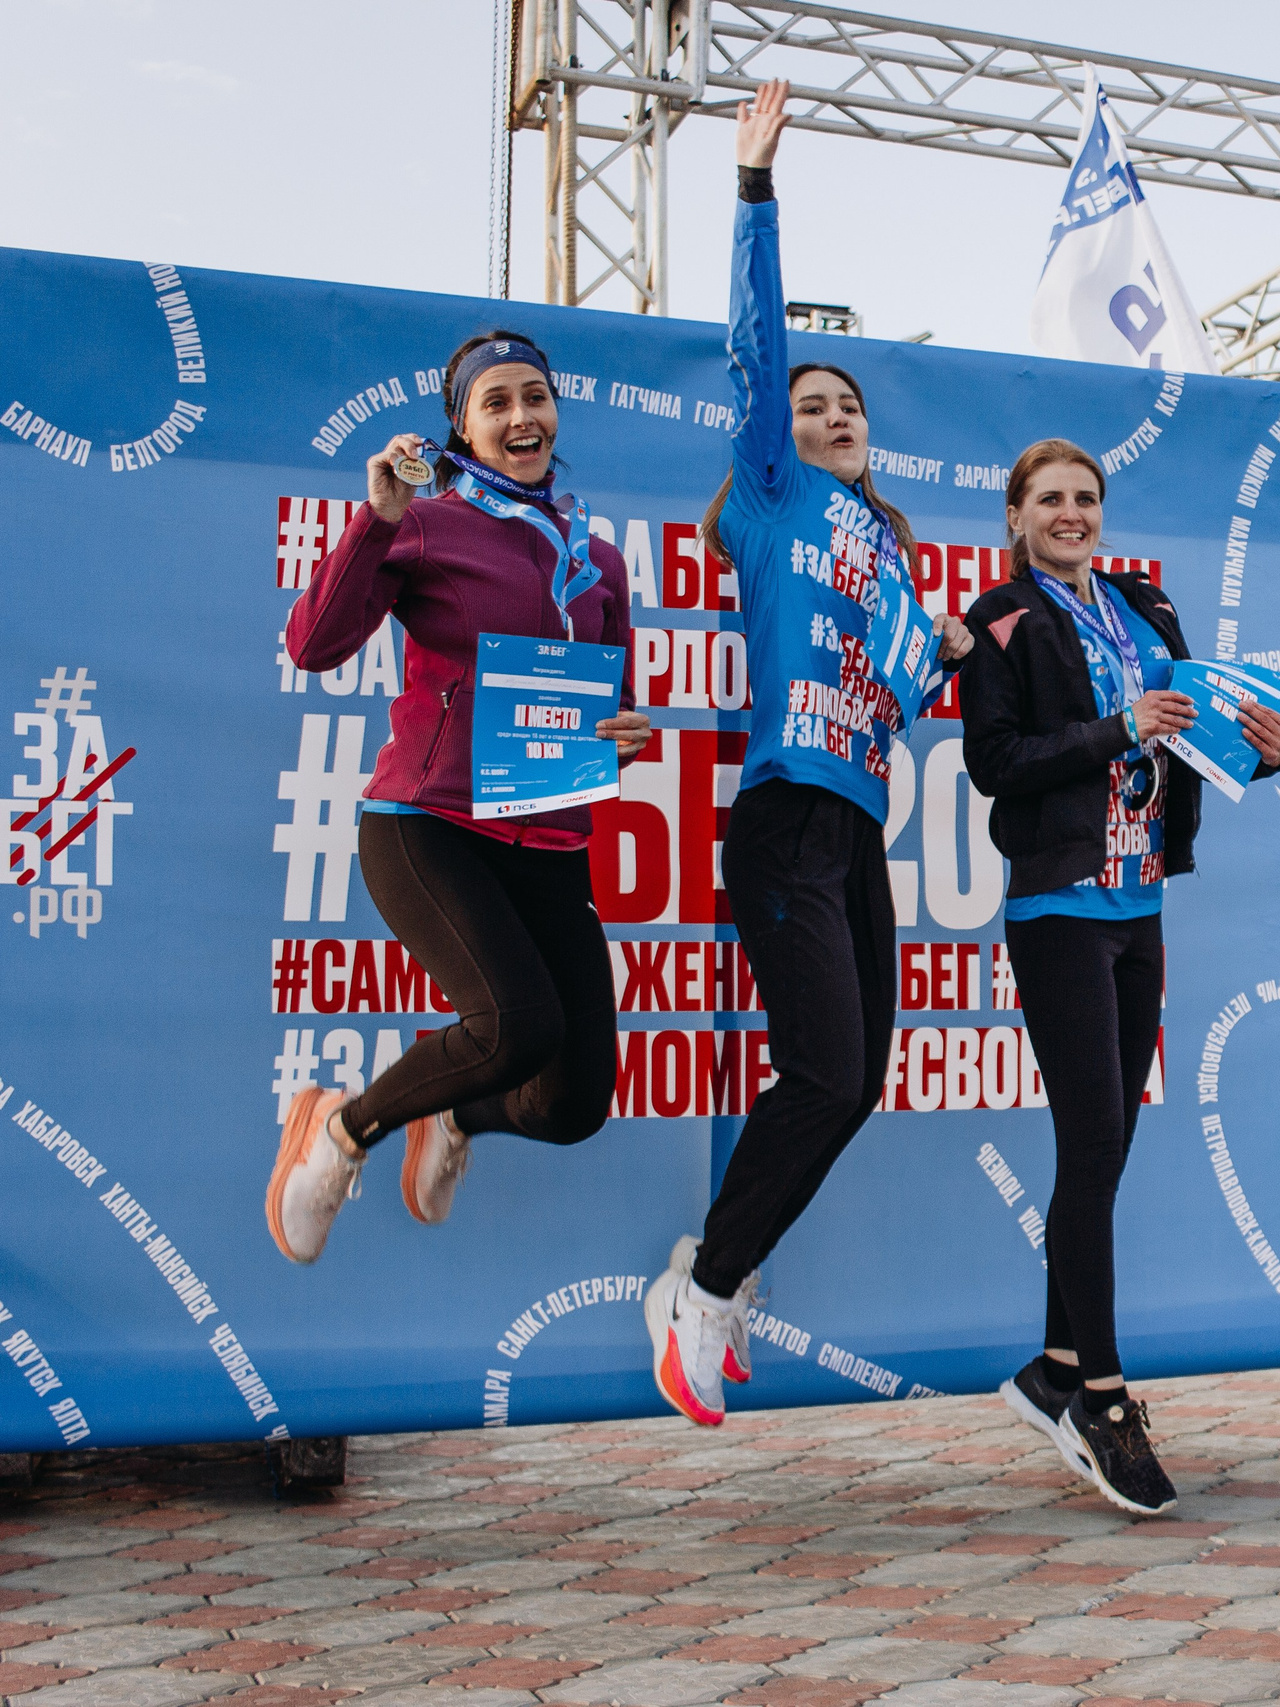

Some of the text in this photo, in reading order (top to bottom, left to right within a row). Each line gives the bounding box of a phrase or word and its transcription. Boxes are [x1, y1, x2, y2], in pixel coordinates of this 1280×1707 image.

[156, 290, 206, 383] ВЕЛИКИЙ
[0, 400, 92, 467] БАРНАУЛ
[311, 377, 409, 457] ВОЛГОГРАД
[609, 382, 682, 420] ГАТЧИНА
[110, 400, 207, 472] БЕЛГОРОД
[954, 463, 1011, 491] ЗАРАЙС
[1100, 417, 1163, 476] ИРКУТСК
[483, 495, 508, 513] ПСБ
[1236, 443, 1276, 509] МАЙКОП
[824, 491, 881, 546] 2024
[1220, 515, 1251, 606] МАХАЧКАЛА
[1216, 618, 1238, 660] МОСК
[526, 742, 564, 759] 10 КМ
[527, 705, 582, 730] МЕСТО
[783, 714, 853, 763] #ЗАБЕГ
[1177, 743, 1194, 758] ПСБ
[513, 803, 537, 811] ПСБ
[1205, 766, 1228, 785] FONBET
[1197, 992, 1252, 1104] ПЕТРОЗАВОДСК
[977, 1142, 1046, 1250] ТЮМЕНЬ ТУЛА
[11, 1100, 280, 1423] ХАБАРОВСК ХАНТЫ-МАНСИЙСК ЧЕЛЯБИНСК
[483, 1275, 647, 1427] АМАРА САНКТ-ПЕТЕРБУРГ
[817, 1342, 903, 1398] СМОЛЕНСК
[1, 1329, 92, 1446] ЯКУТСК ЯЛТА
